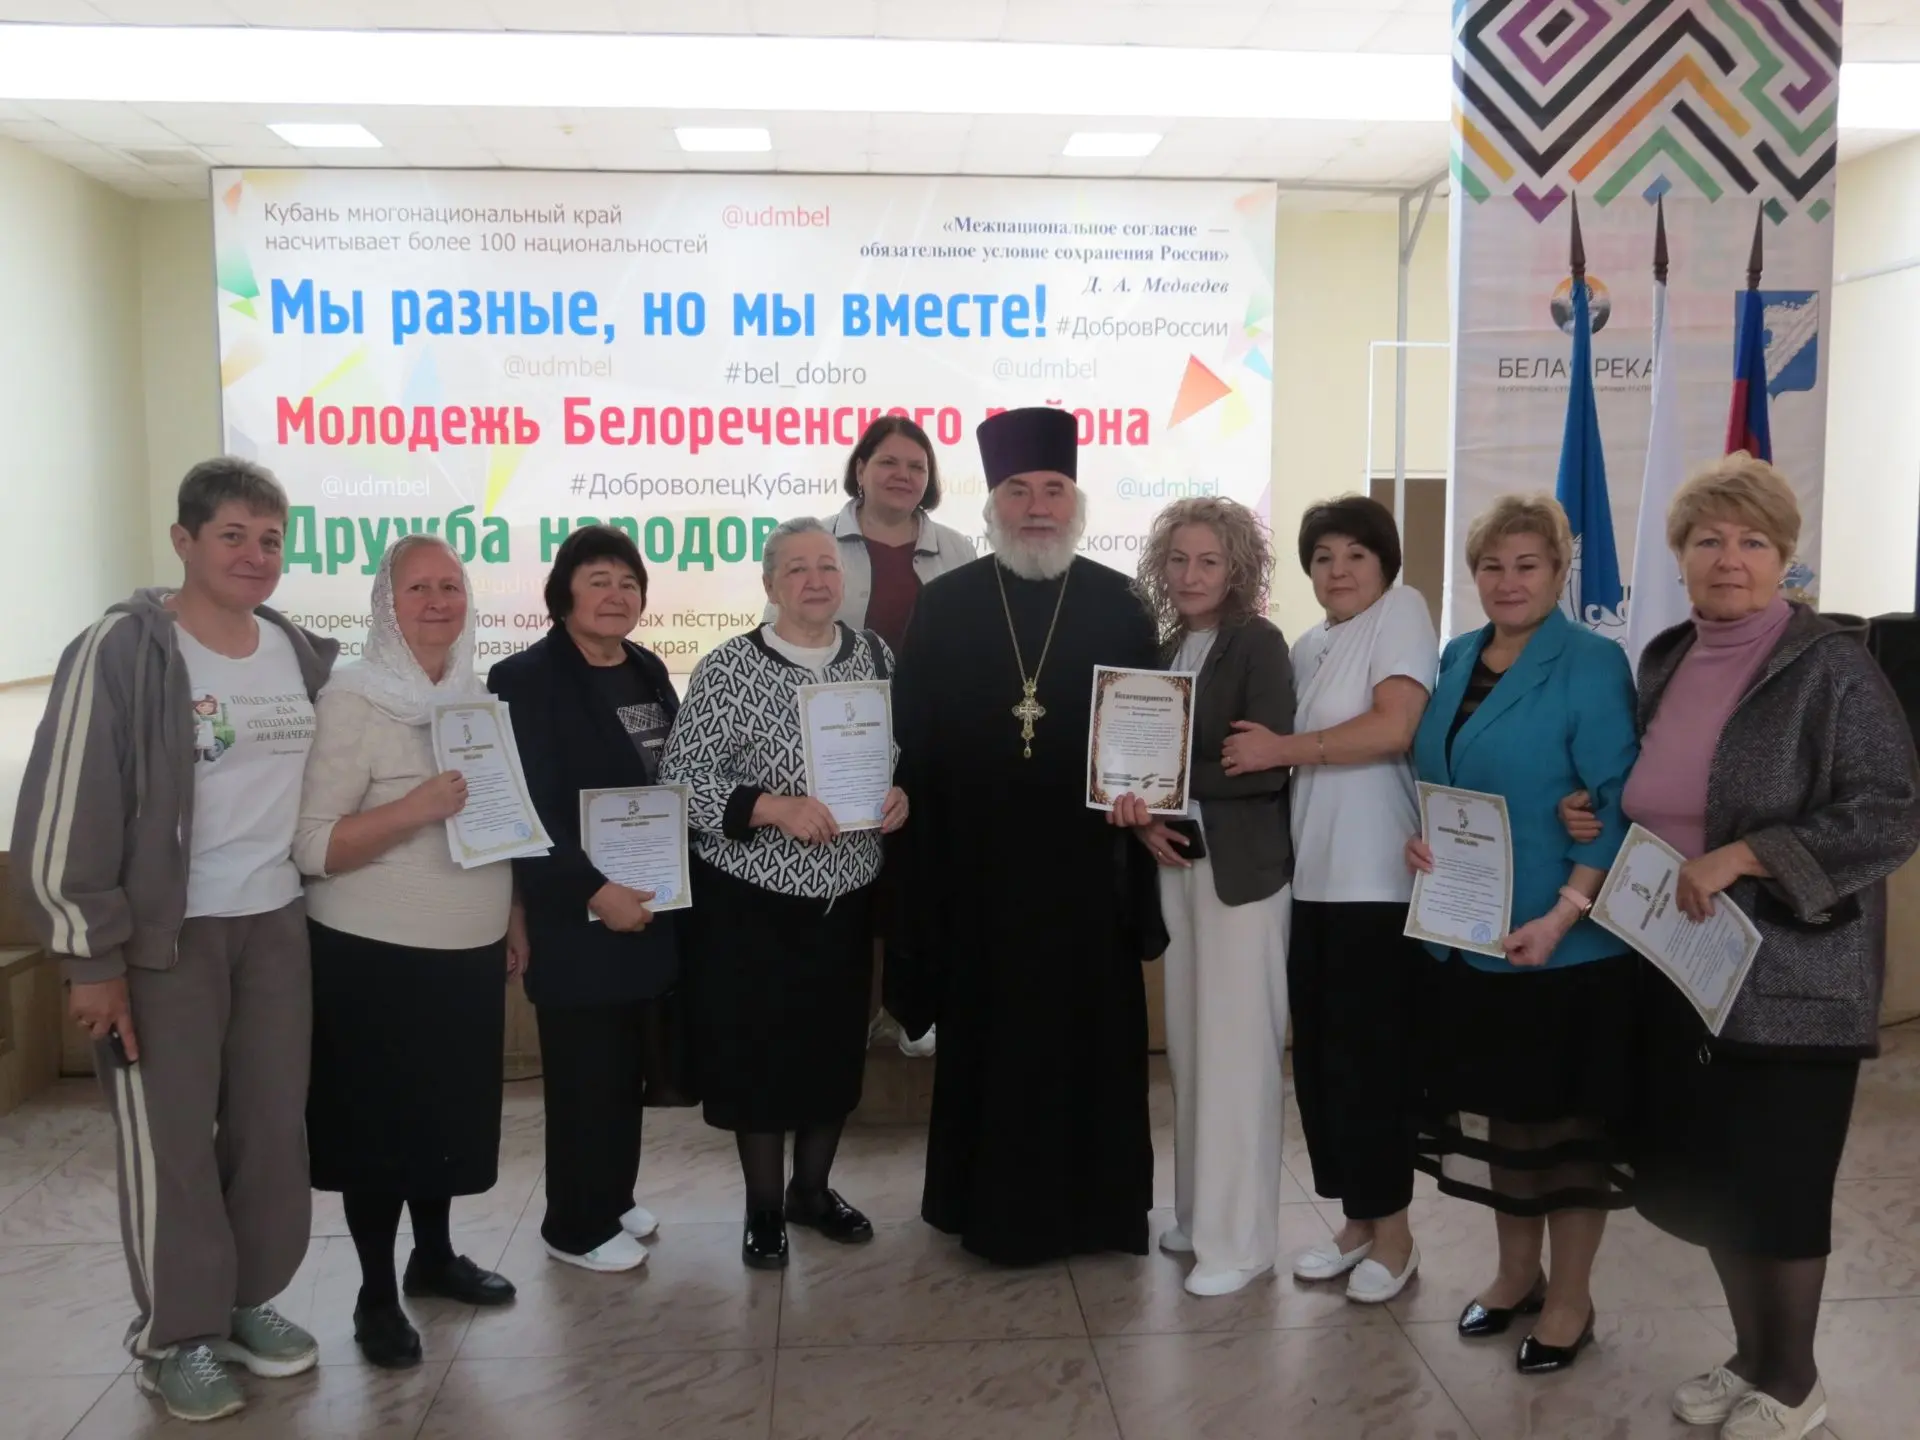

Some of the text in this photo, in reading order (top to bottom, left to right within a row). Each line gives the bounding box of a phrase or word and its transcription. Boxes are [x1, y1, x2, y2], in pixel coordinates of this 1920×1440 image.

[264, 203, 622, 228] Кубань многонациональный край
[721, 206, 830, 228] @udmbel
[943, 217, 1117, 238] «Межнациональное
[1122, 223, 1197, 238] согласие
[265, 231, 708, 255] насчитывает более 100 национальностей
[860, 242, 1229, 263] обязательное условие сохранения России»
[1082, 276, 1229, 295] Д. А. Медведев
[270, 278, 1047, 345] Мы разные, но мы вместе!
[1056, 316, 1229, 341] #ДобровРоссии
[503, 355, 613, 380] @udmbel
[725, 361, 867, 388] #bel_dobro
[992, 357, 1098, 382] @udmbel
[1498, 357, 1654, 379] БЕЛА РЕКА
[276, 396, 540, 453] Молодежь
[563, 396, 962, 455] Белореченскго
[321, 474, 430, 499] @udmbel
[570, 473, 838, 500] #ДоброволецКубани
[672, 609, 756, 633] пёстрых
[653, 640, 699, 659] края
